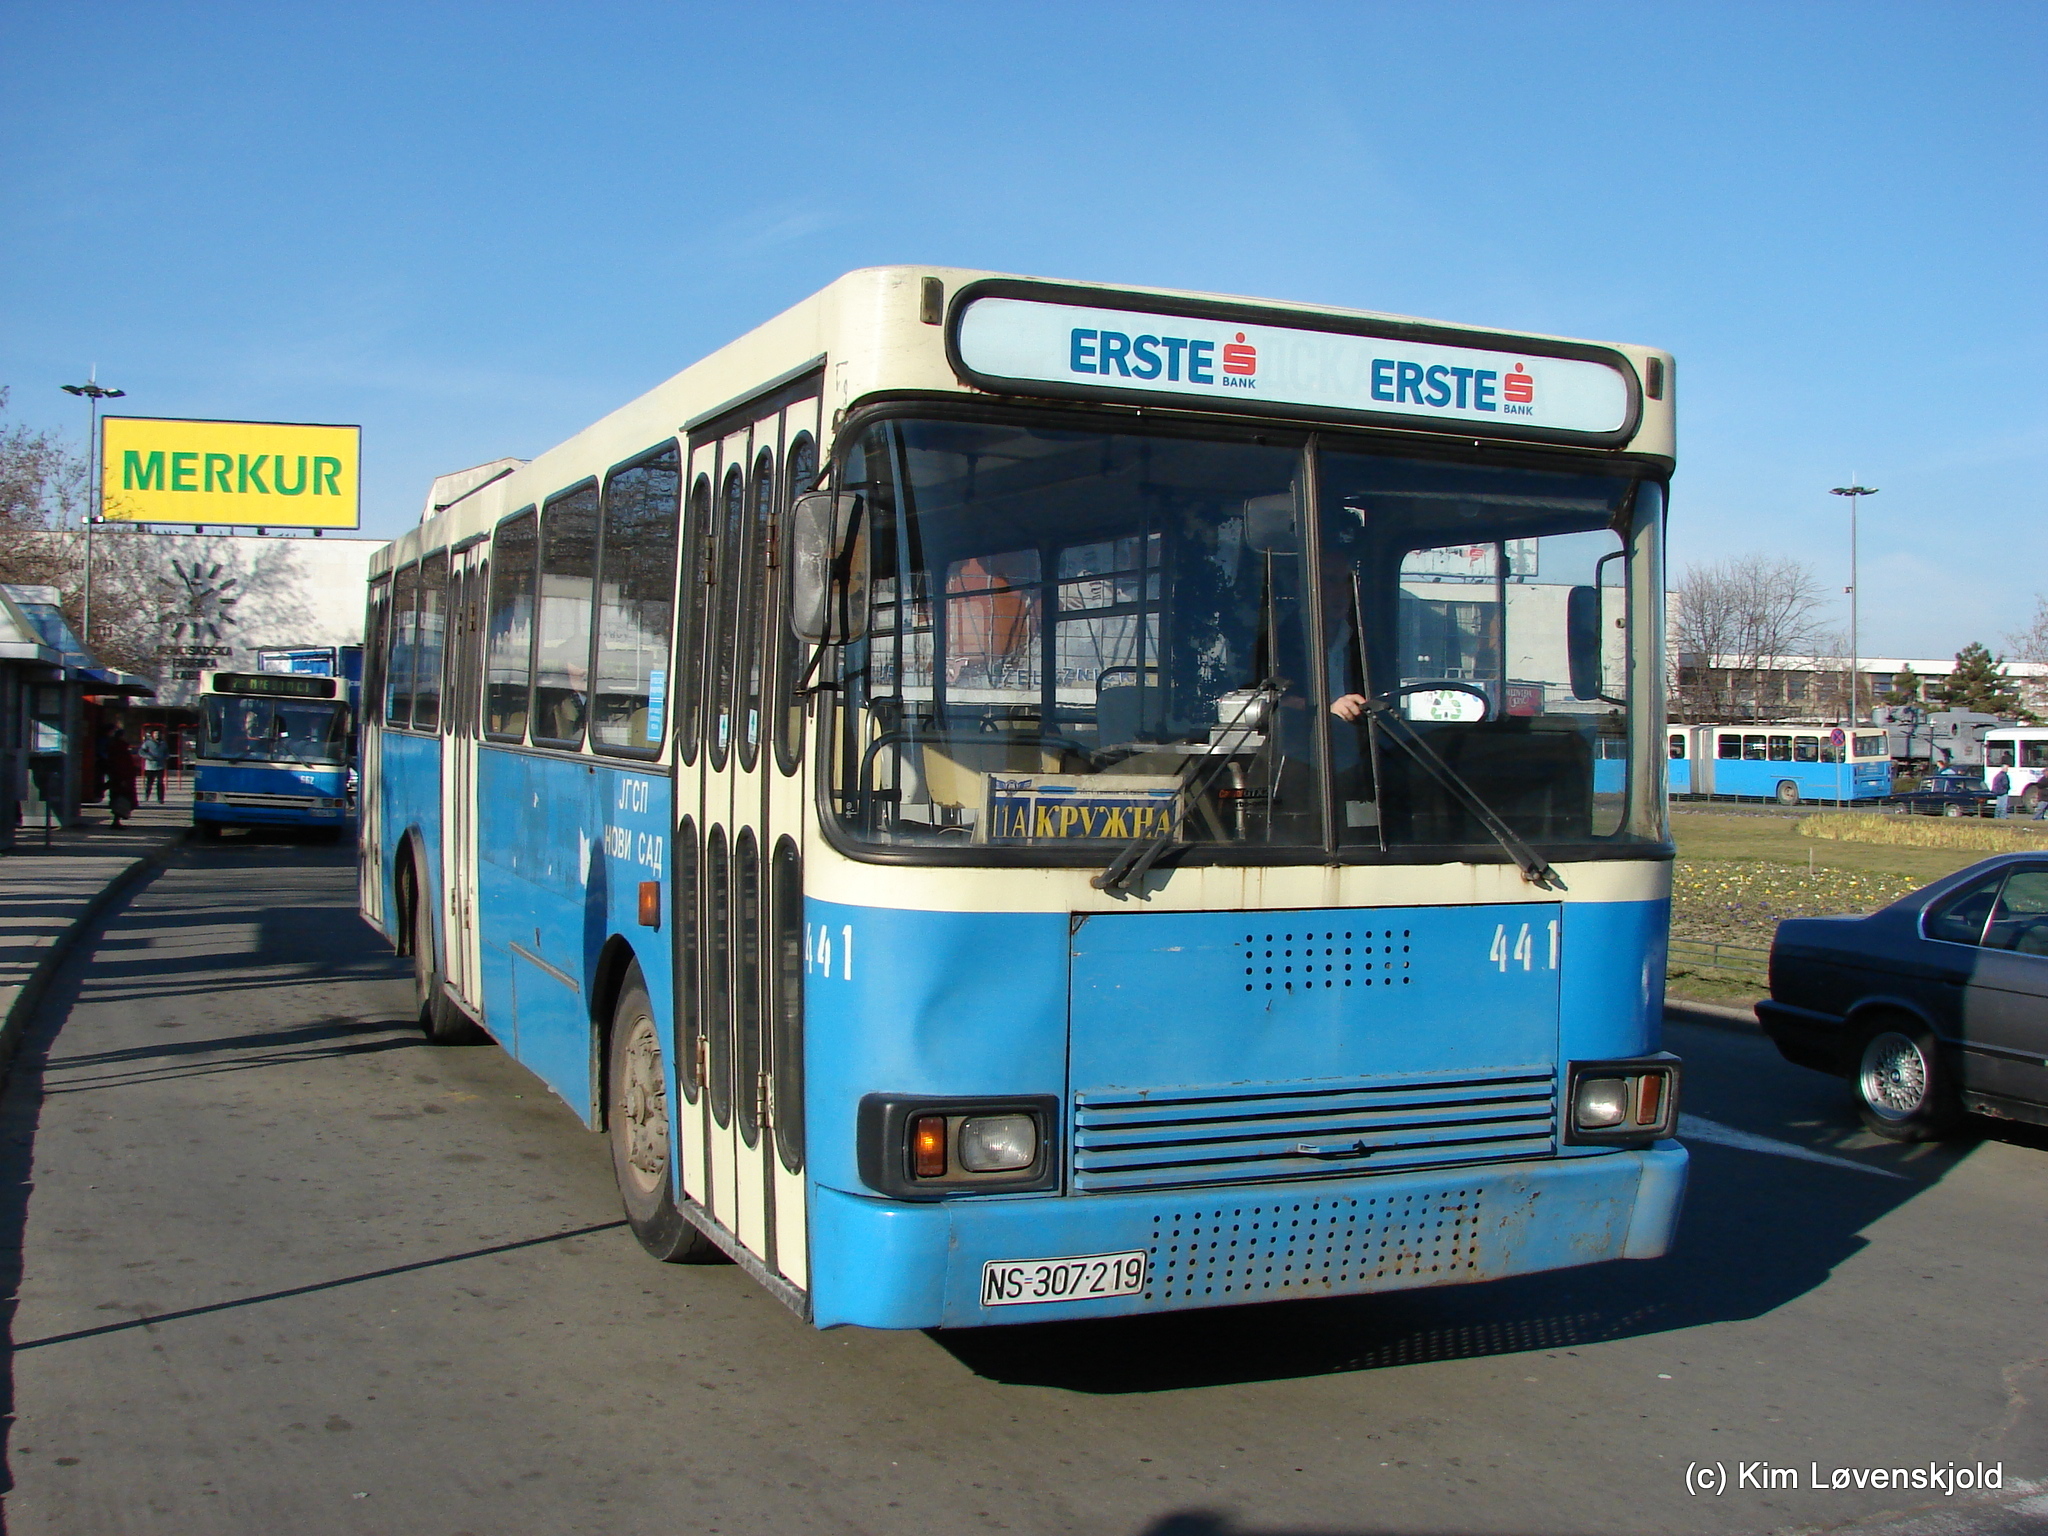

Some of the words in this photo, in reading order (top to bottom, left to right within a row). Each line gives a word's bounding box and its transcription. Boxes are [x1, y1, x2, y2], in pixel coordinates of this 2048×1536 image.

[1070, 327, 1215, 384] ERSTE
[1222, 376, 1256, 389] BANK
[1371, 358, 1497, 412] ERSTE
[1503, 404, 1533, 416] BANK
[123, 449, 343, 497] MERKUR
[618, 779, 649, 814] ЈГСП
[1036, 804, 1172, 839] КРУЖНА
[604, 824, 632, 861] НОВИ
[638, 831, 663, 879] САД
[1489, 920, 1558, 973] 441
